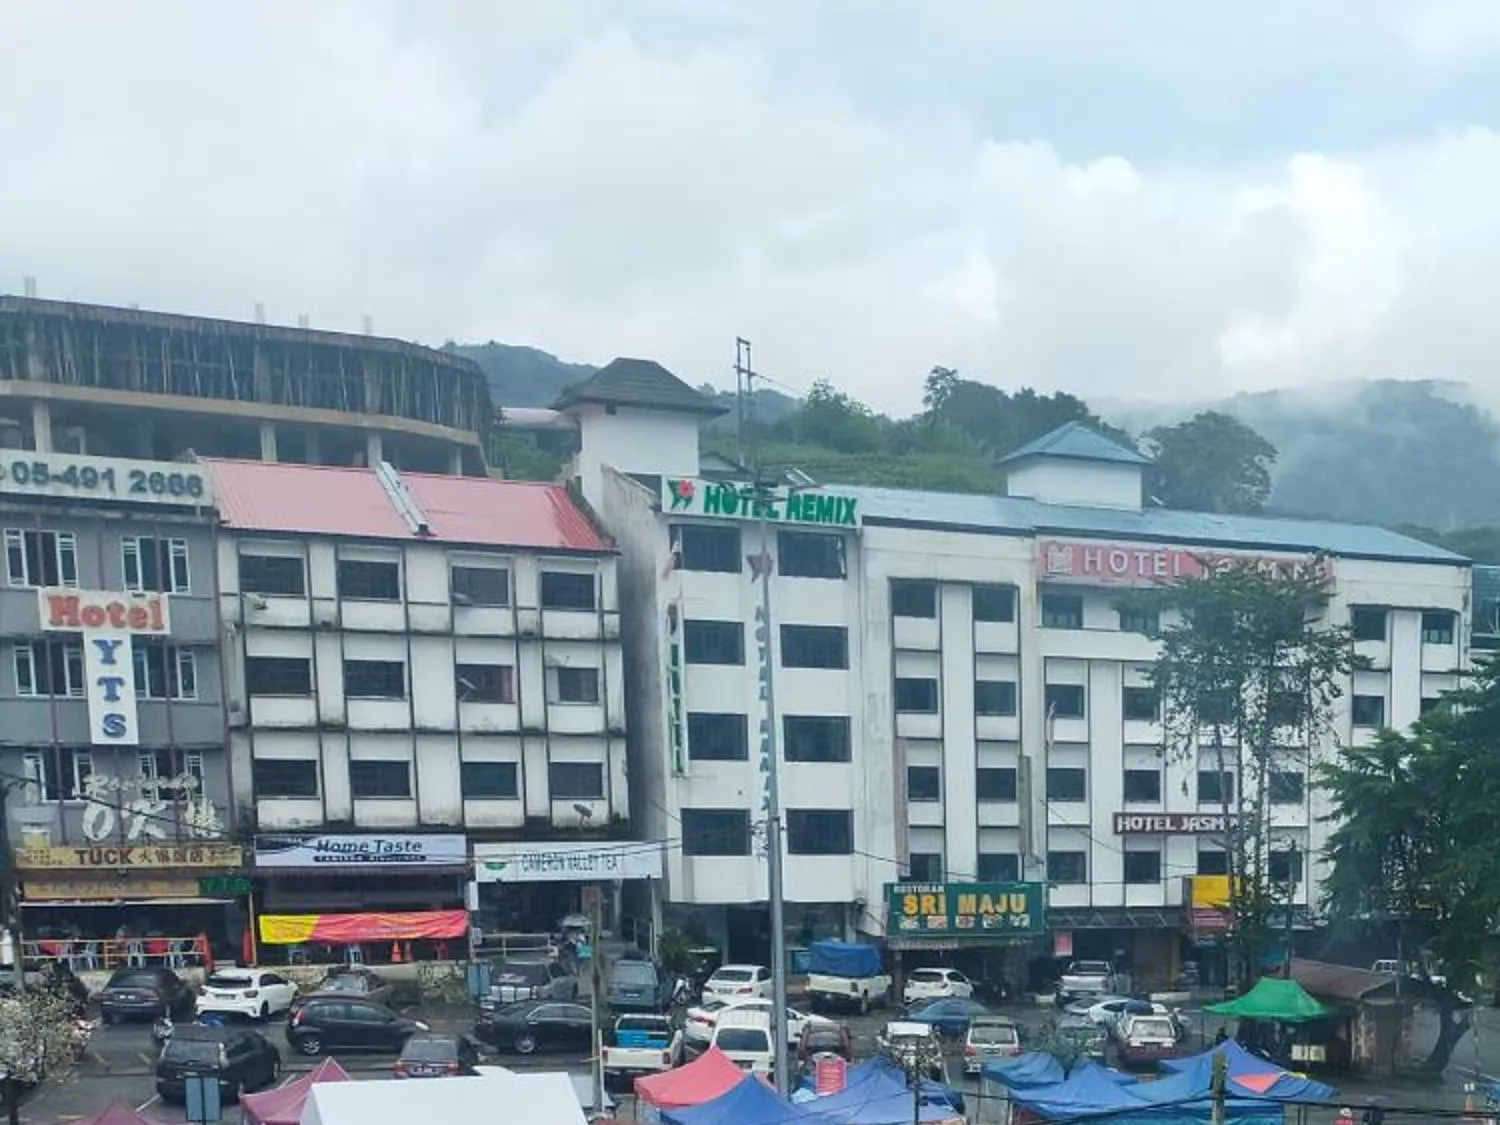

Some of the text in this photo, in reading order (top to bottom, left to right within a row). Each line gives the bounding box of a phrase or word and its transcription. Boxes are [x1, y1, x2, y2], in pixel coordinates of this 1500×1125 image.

[11, 460, 116, 493] 05-491
[703, 482, 857, 526] HOTEL REMIX
[47, 594, 165, 631] Hotel
[92, 639, 127, 738] YTS
[1116, 815, 1177, 832] HOTEL
[74, 850, 132, 866] TUCK
[316, 838, 423, 854] Home Taste
[903, 894, 1027, 915] SRI MAJU
